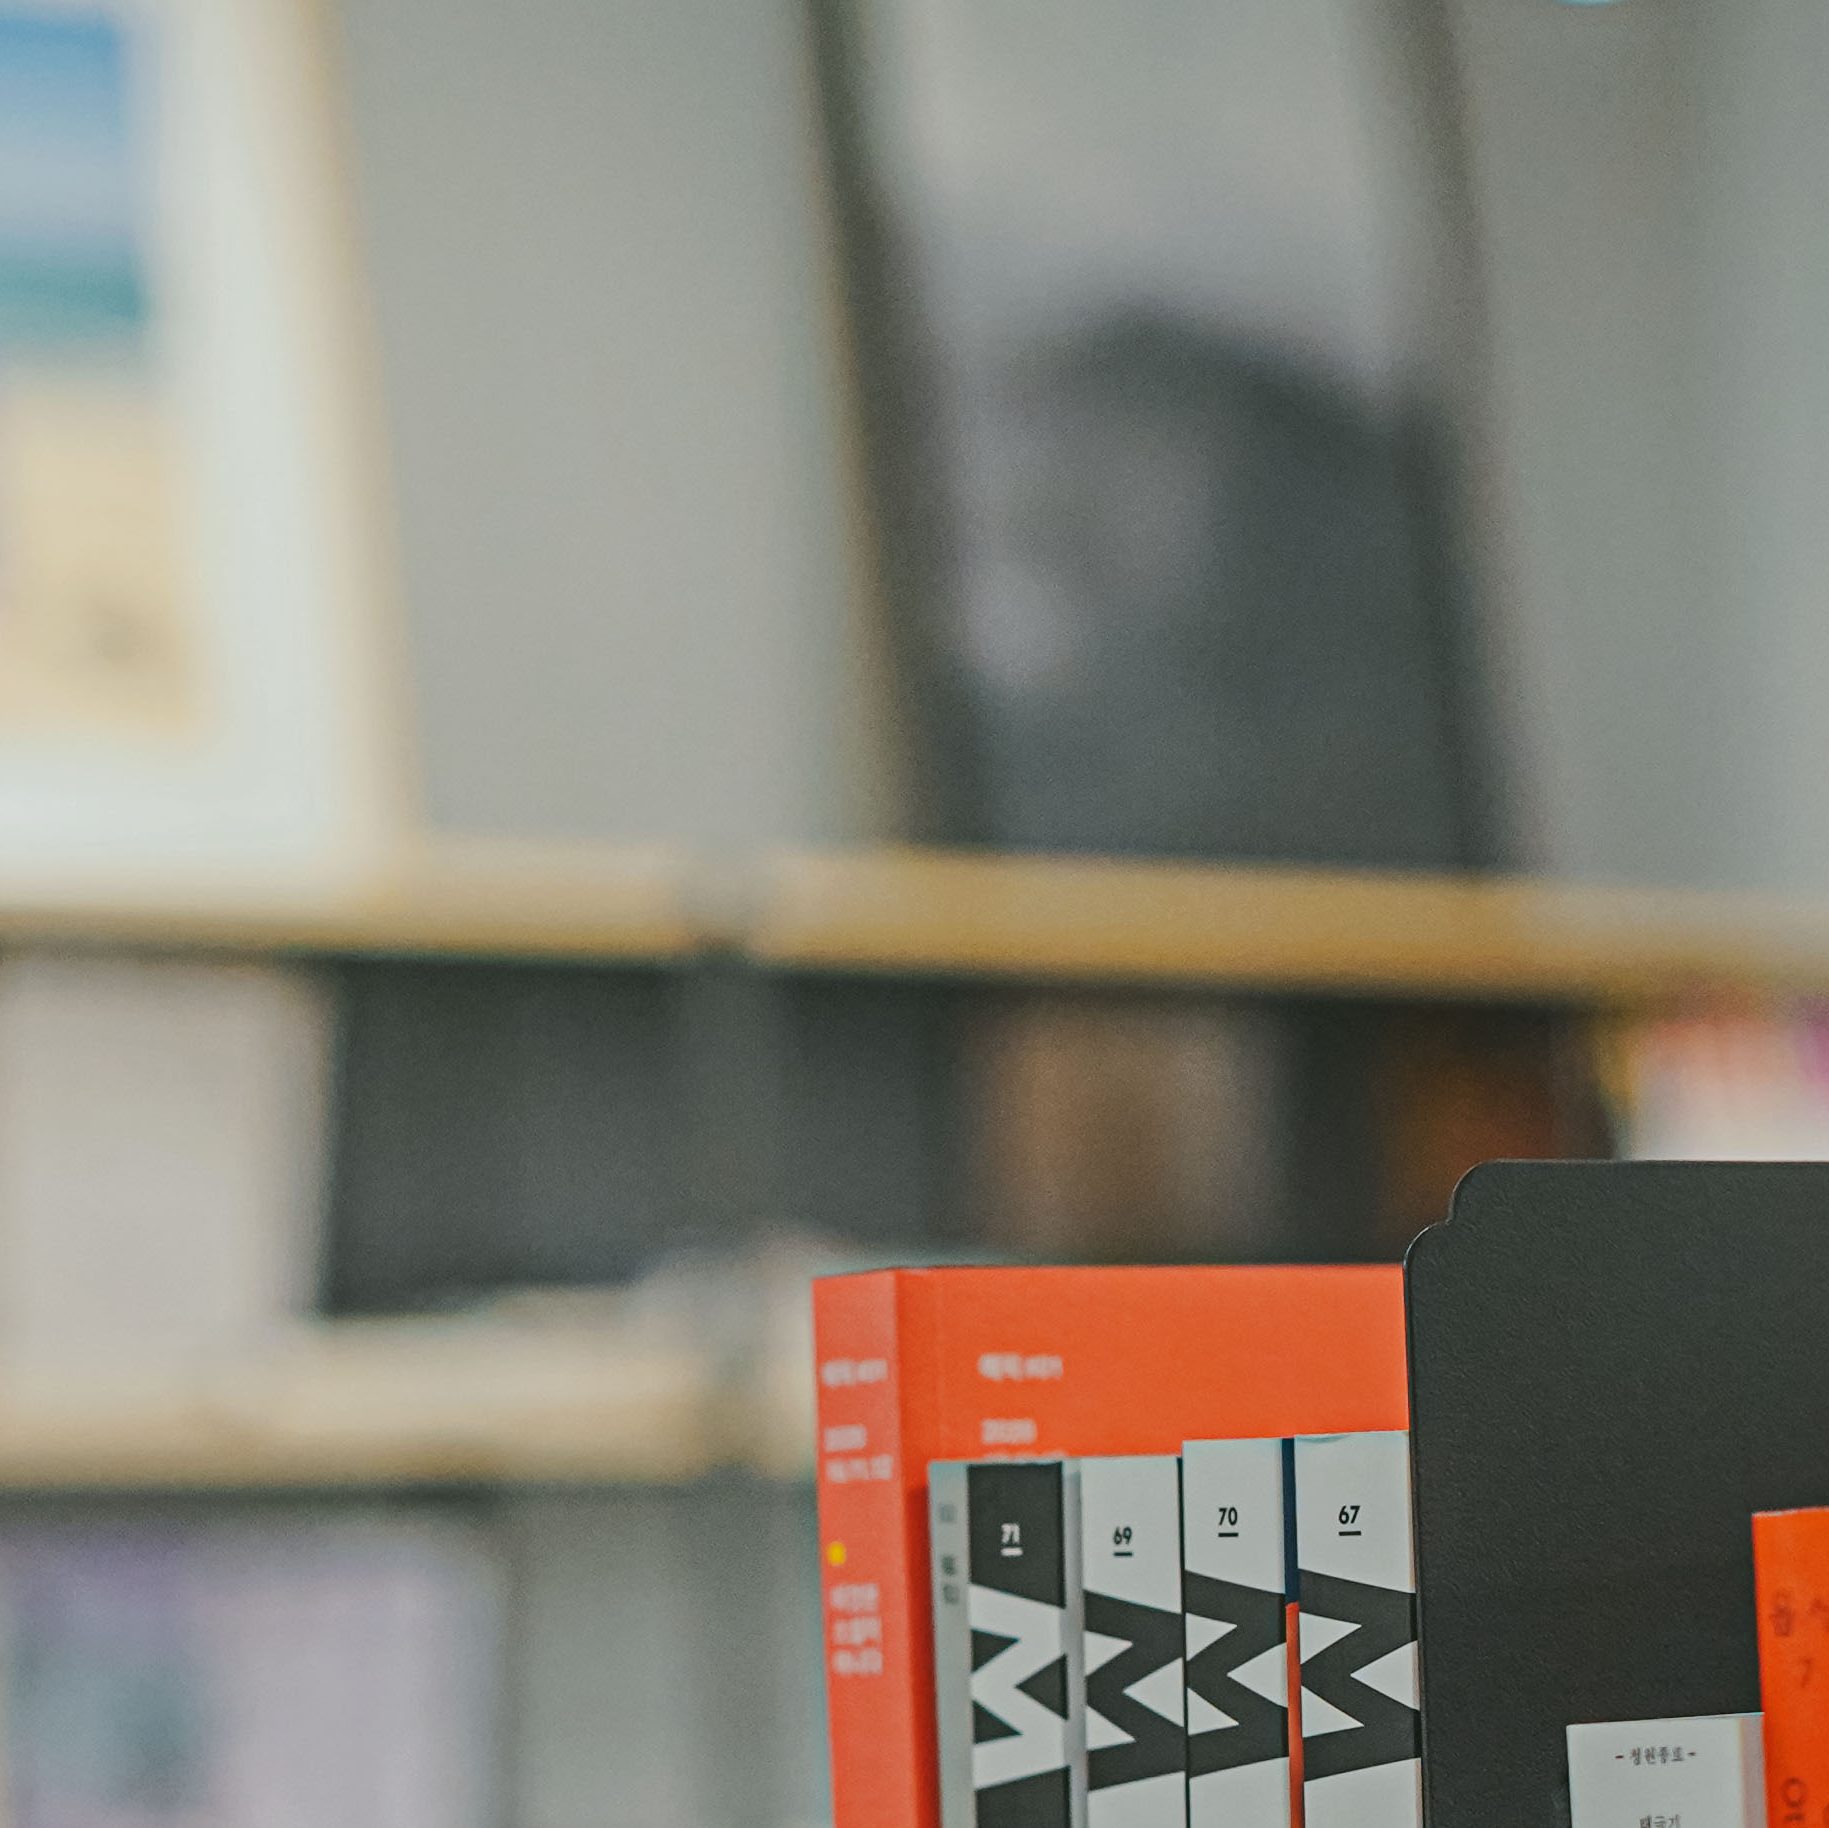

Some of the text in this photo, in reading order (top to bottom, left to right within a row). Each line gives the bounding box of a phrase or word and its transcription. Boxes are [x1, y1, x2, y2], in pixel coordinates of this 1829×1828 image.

[1218, 1507, 1238, 1525] 70
[1338, 1505, 1360, 1524] 67
[1001, 1523, 1020, 1545] 71
[1113, 1526, 1133, 1545] 69
